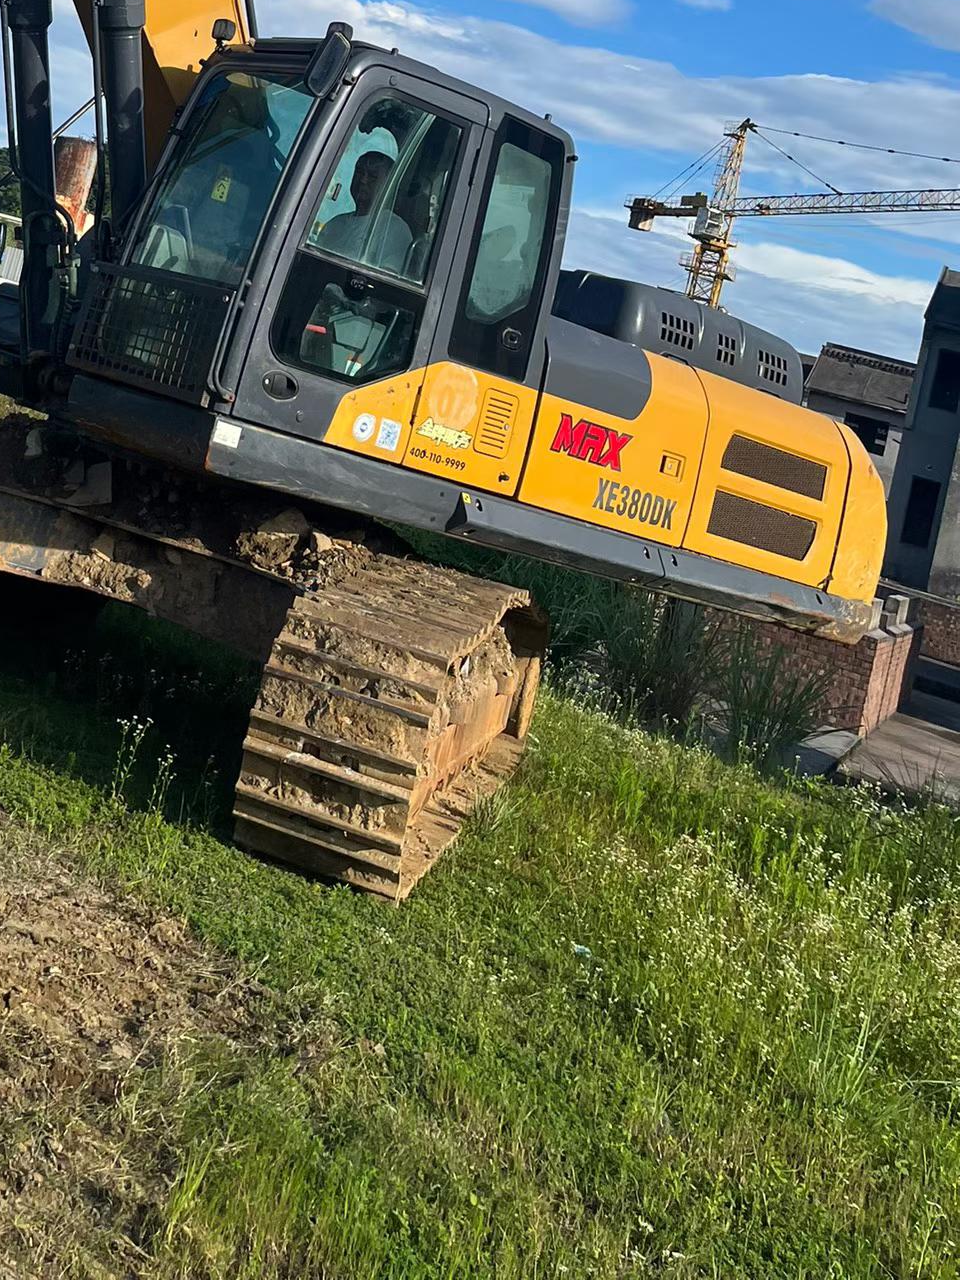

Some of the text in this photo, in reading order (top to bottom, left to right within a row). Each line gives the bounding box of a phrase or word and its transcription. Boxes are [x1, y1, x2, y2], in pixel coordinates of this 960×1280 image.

[409, 447, 466, 471] 400-110-9999
[550, 412, 634, 472] MAX
[592, 477, 677, 530] XE380DK
